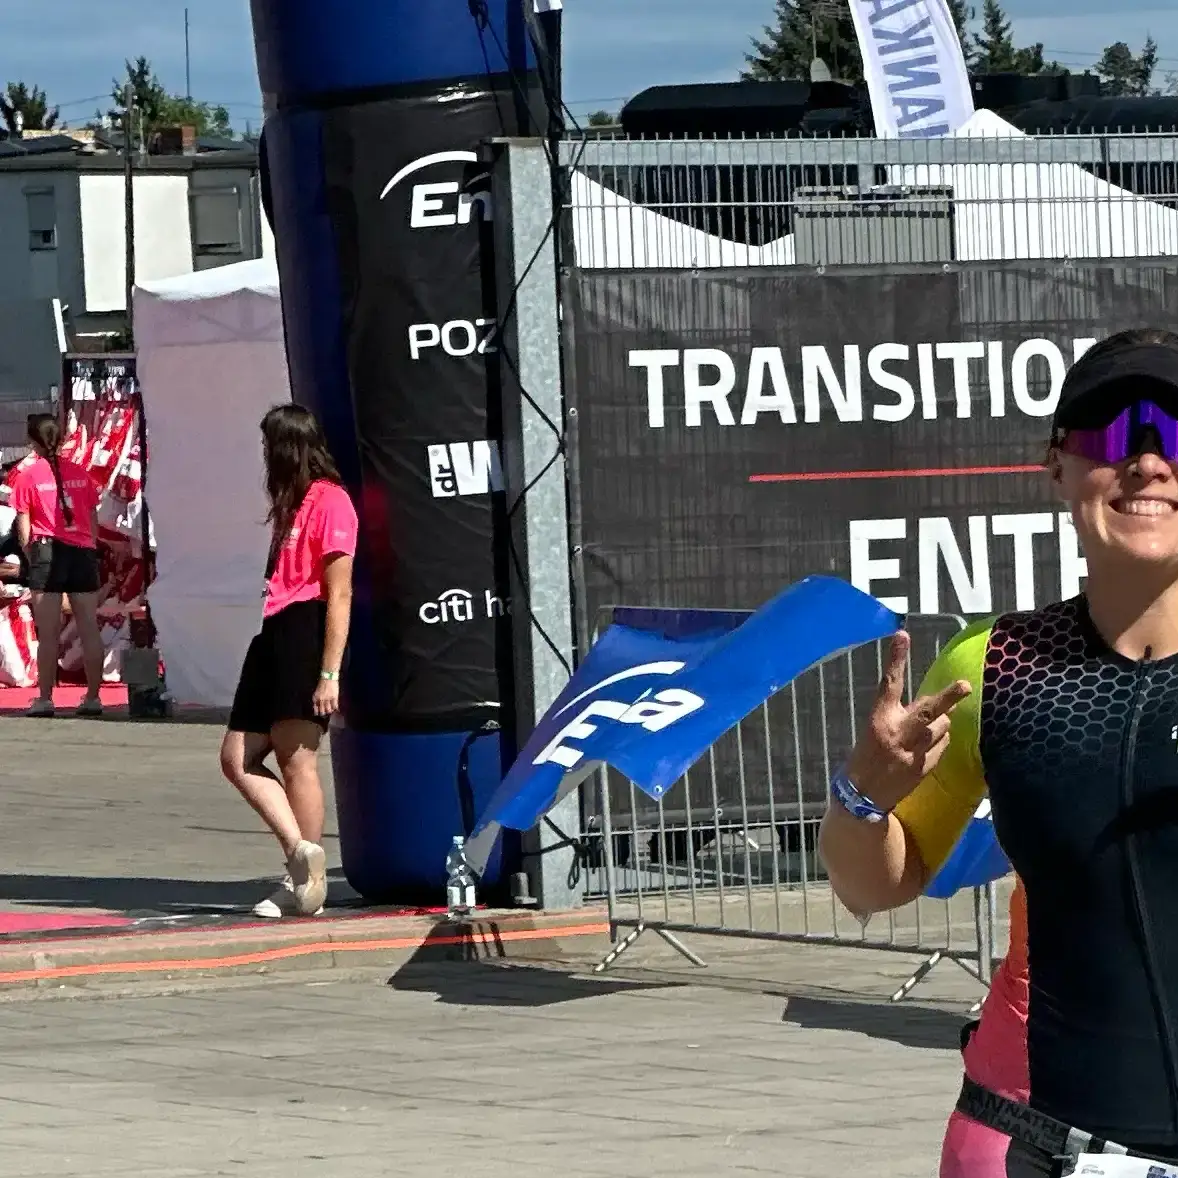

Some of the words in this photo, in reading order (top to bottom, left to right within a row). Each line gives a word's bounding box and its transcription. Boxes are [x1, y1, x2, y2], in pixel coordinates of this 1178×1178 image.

[410, 181, 493, 228] En
[408, 318, 498, 360] POZ
[628, 337, 1097, 428] TRANSITIO
